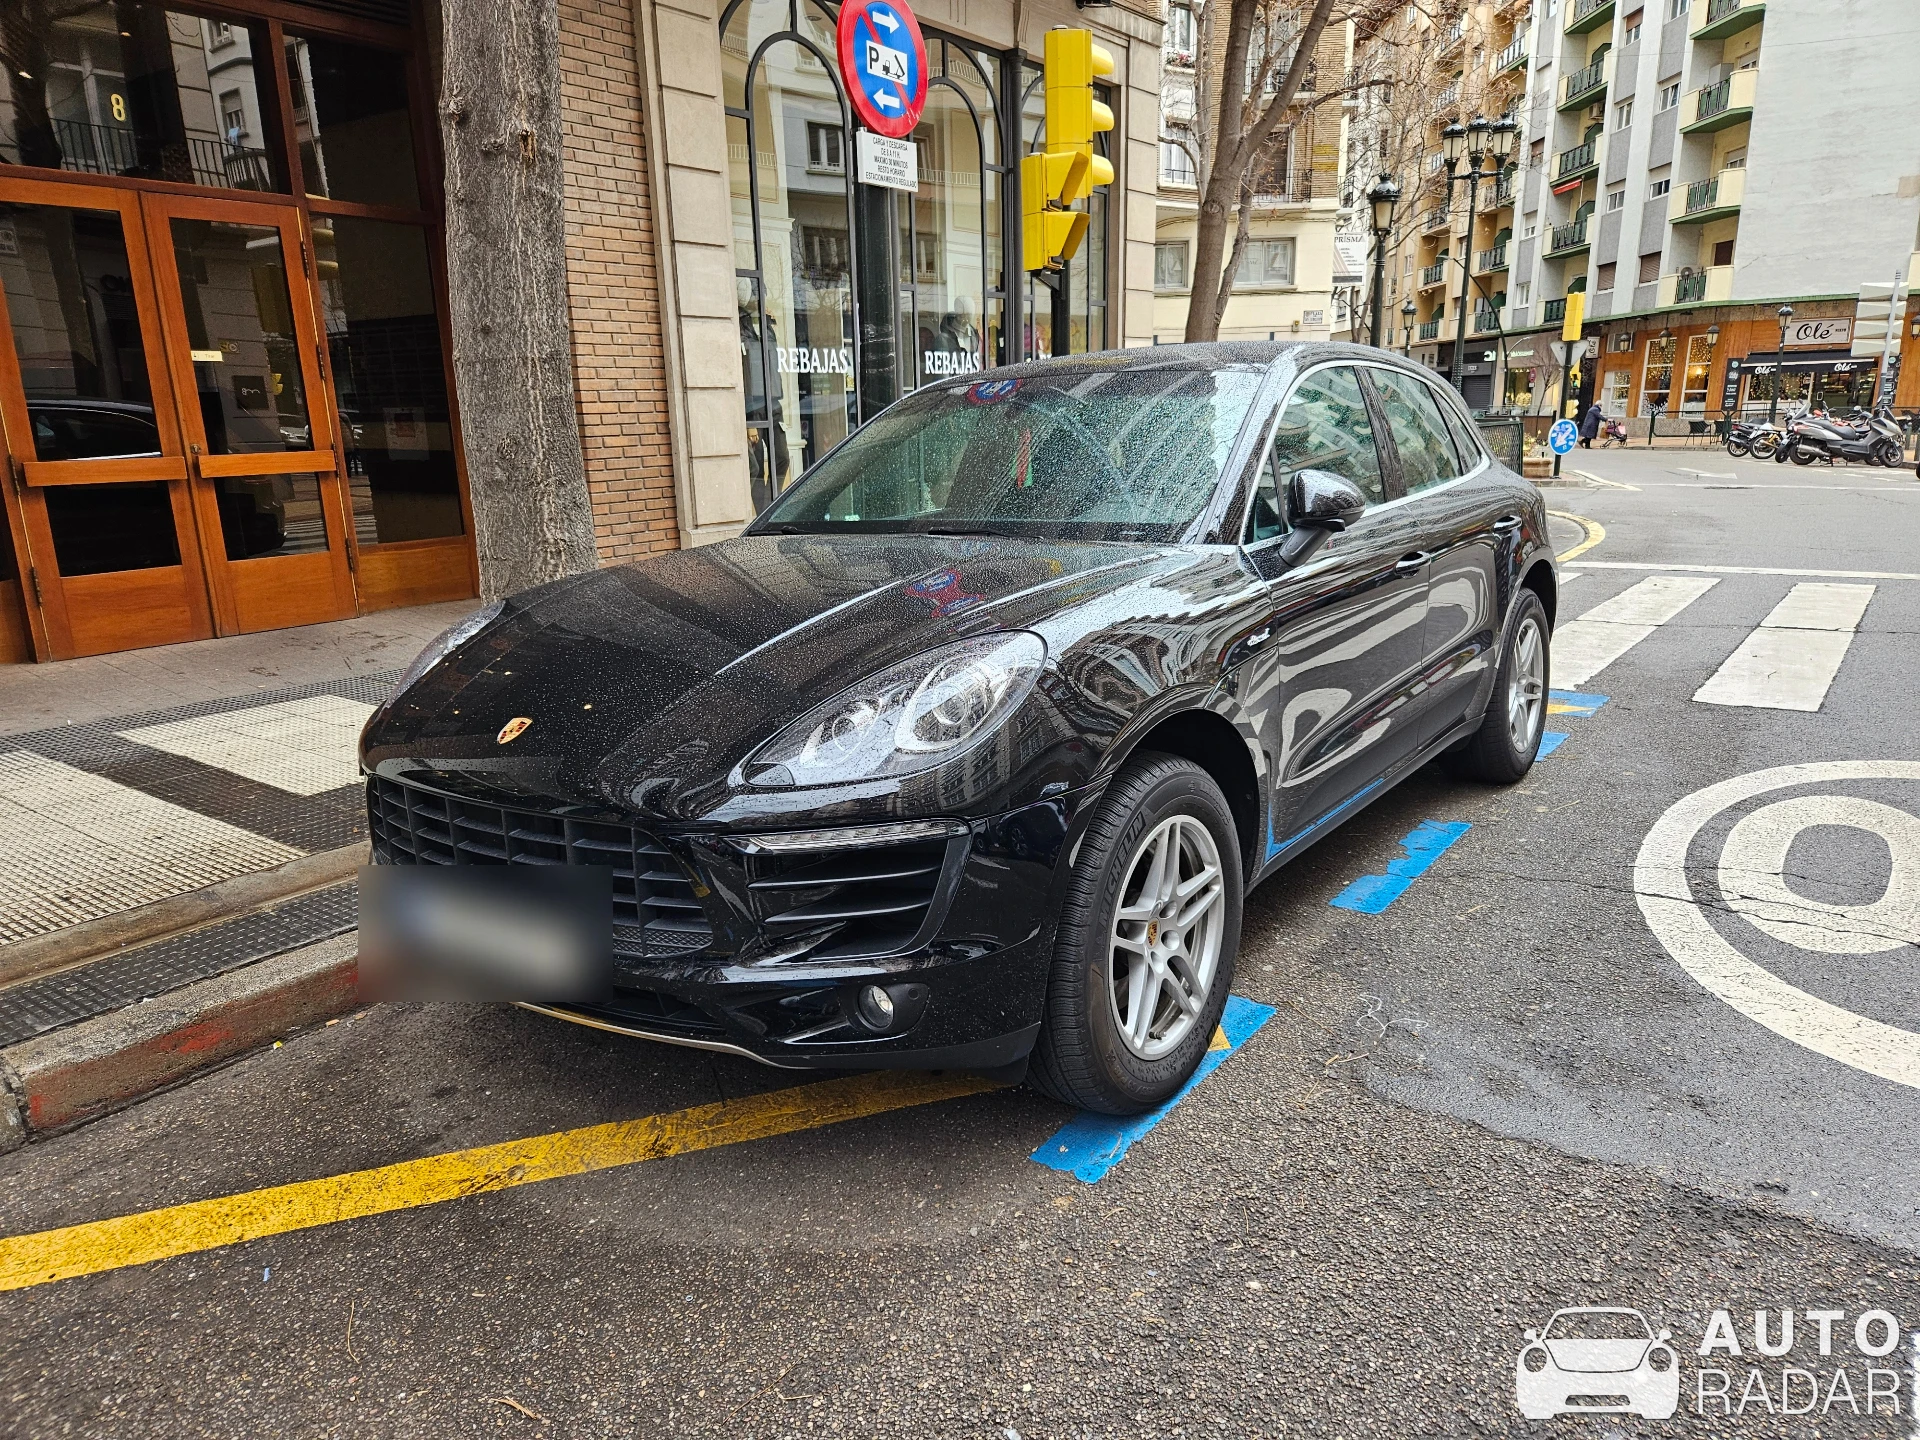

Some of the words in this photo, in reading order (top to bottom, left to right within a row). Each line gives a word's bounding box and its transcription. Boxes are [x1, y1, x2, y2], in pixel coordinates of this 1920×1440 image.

[869, 45, 879, 70] P
[110, 93, 126, 121] 8
[873, 137, 885, 146] CARGA
[889, 140, 908, 151] DESCARGA
[1796, 322, 1834, 341] Olé
[777, 348, 850, 374] REBAJAS
[924, 351, 980, 375] REBAJAS
[1099, 810, 1147, 930] MICHELIN
